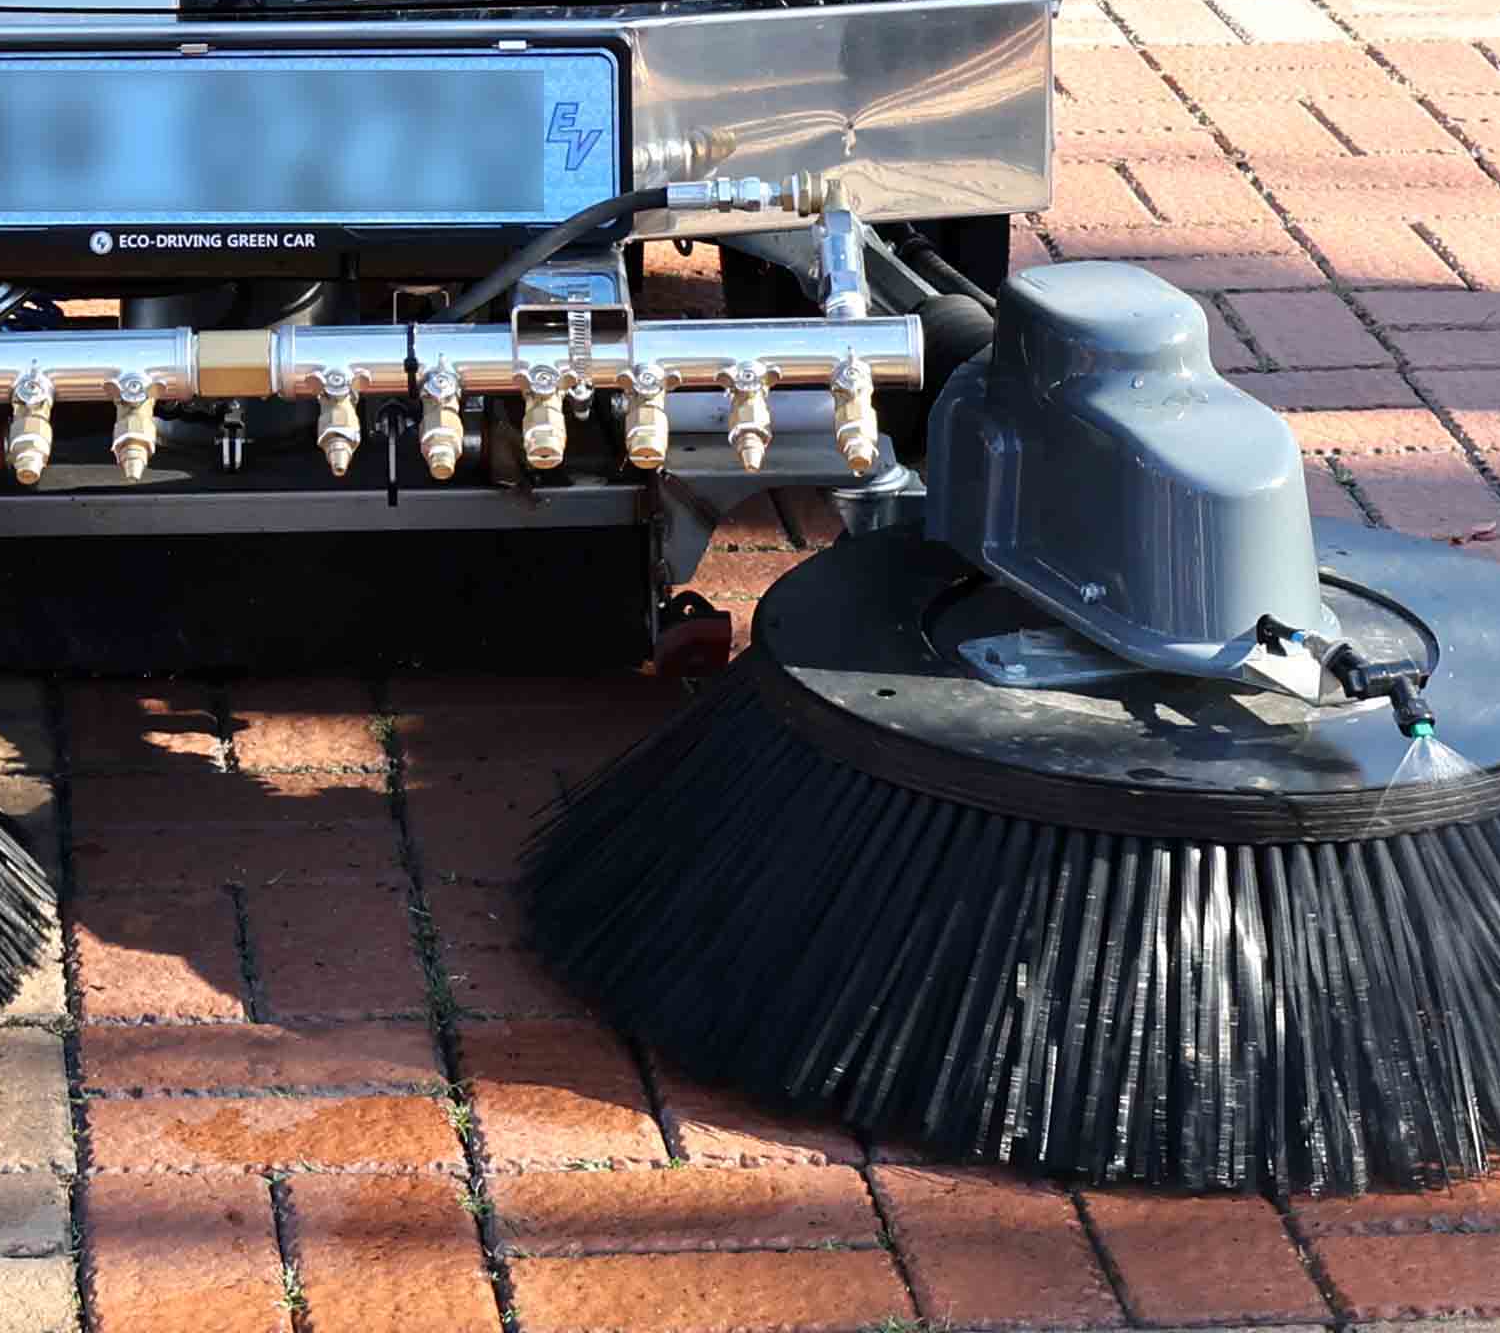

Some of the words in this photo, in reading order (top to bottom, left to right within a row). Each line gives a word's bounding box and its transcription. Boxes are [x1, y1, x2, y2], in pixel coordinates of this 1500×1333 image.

[546, 102, 603, 172] EV
[118, 233, 223, 250] ECO-DRIVING
[226, 233, 279, 249] GREEN
[283, 232, 316, 248] CAR
